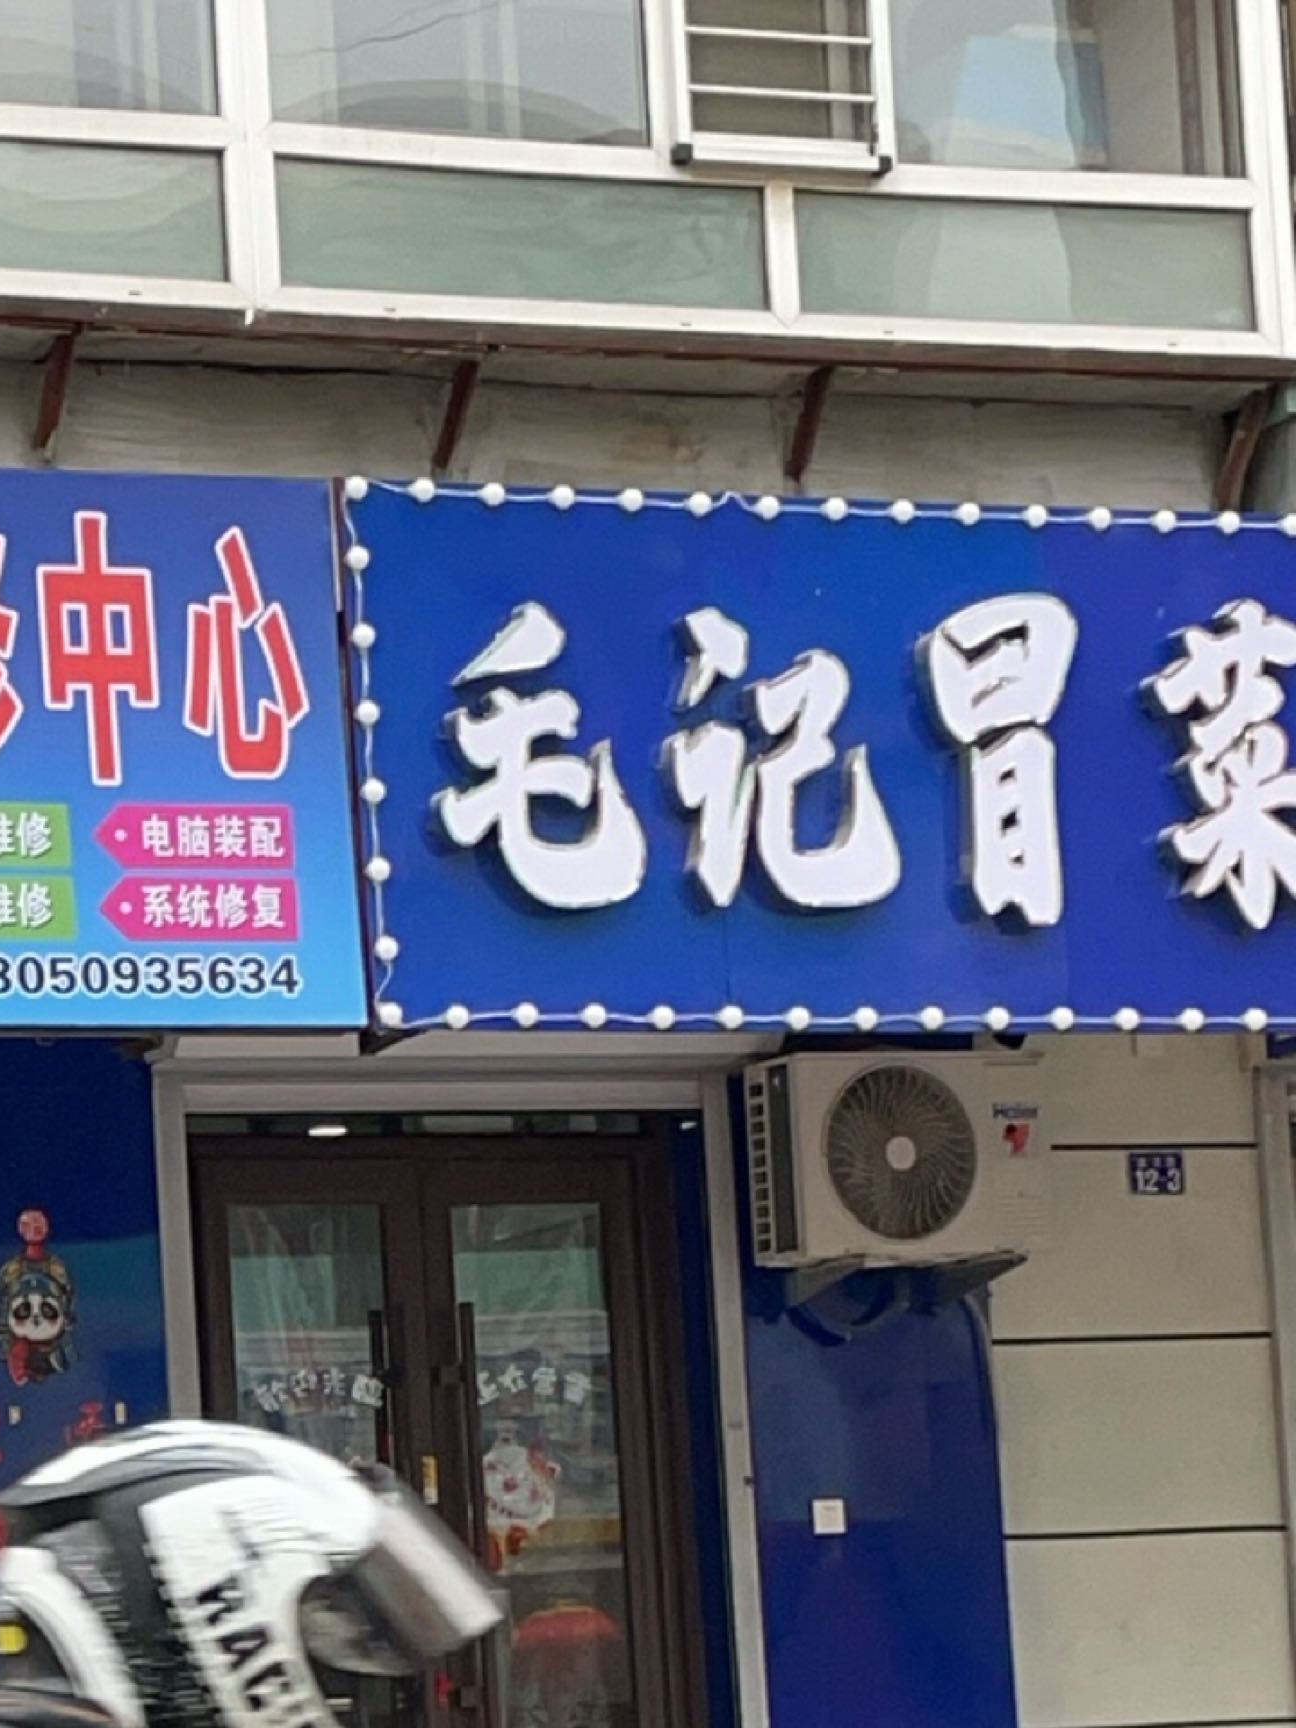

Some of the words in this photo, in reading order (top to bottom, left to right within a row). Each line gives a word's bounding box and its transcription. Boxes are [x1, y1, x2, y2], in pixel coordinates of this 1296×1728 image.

[431, 590, 1296, 931] 毛记冒菜
[141, 814, 285, 860] 电脑装配
[141, 883, 286, 930] 系统修复
